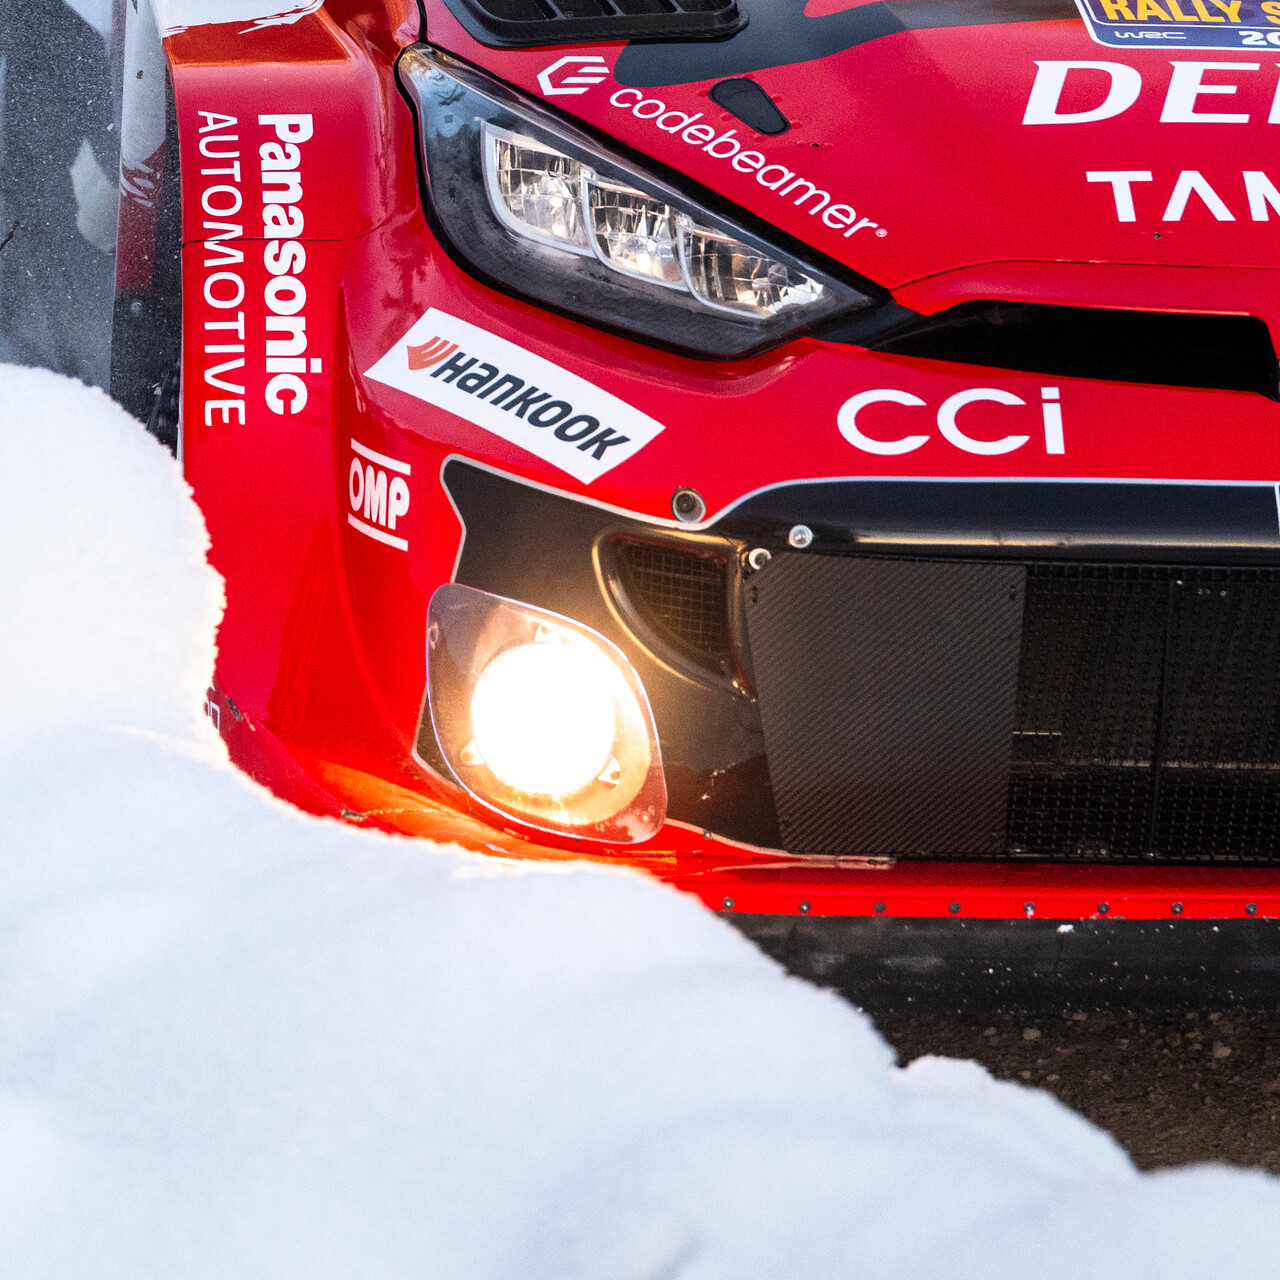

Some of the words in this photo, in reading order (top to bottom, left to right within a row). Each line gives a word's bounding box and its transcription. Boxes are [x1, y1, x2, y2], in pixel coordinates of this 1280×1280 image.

[1114, 30, 1187, 40] WRC
[197, 110, 247, 427] AUTOMOTIVE
[258, 113, 322, 416] Panasonic
[348, 456, 411, 531] OMP
